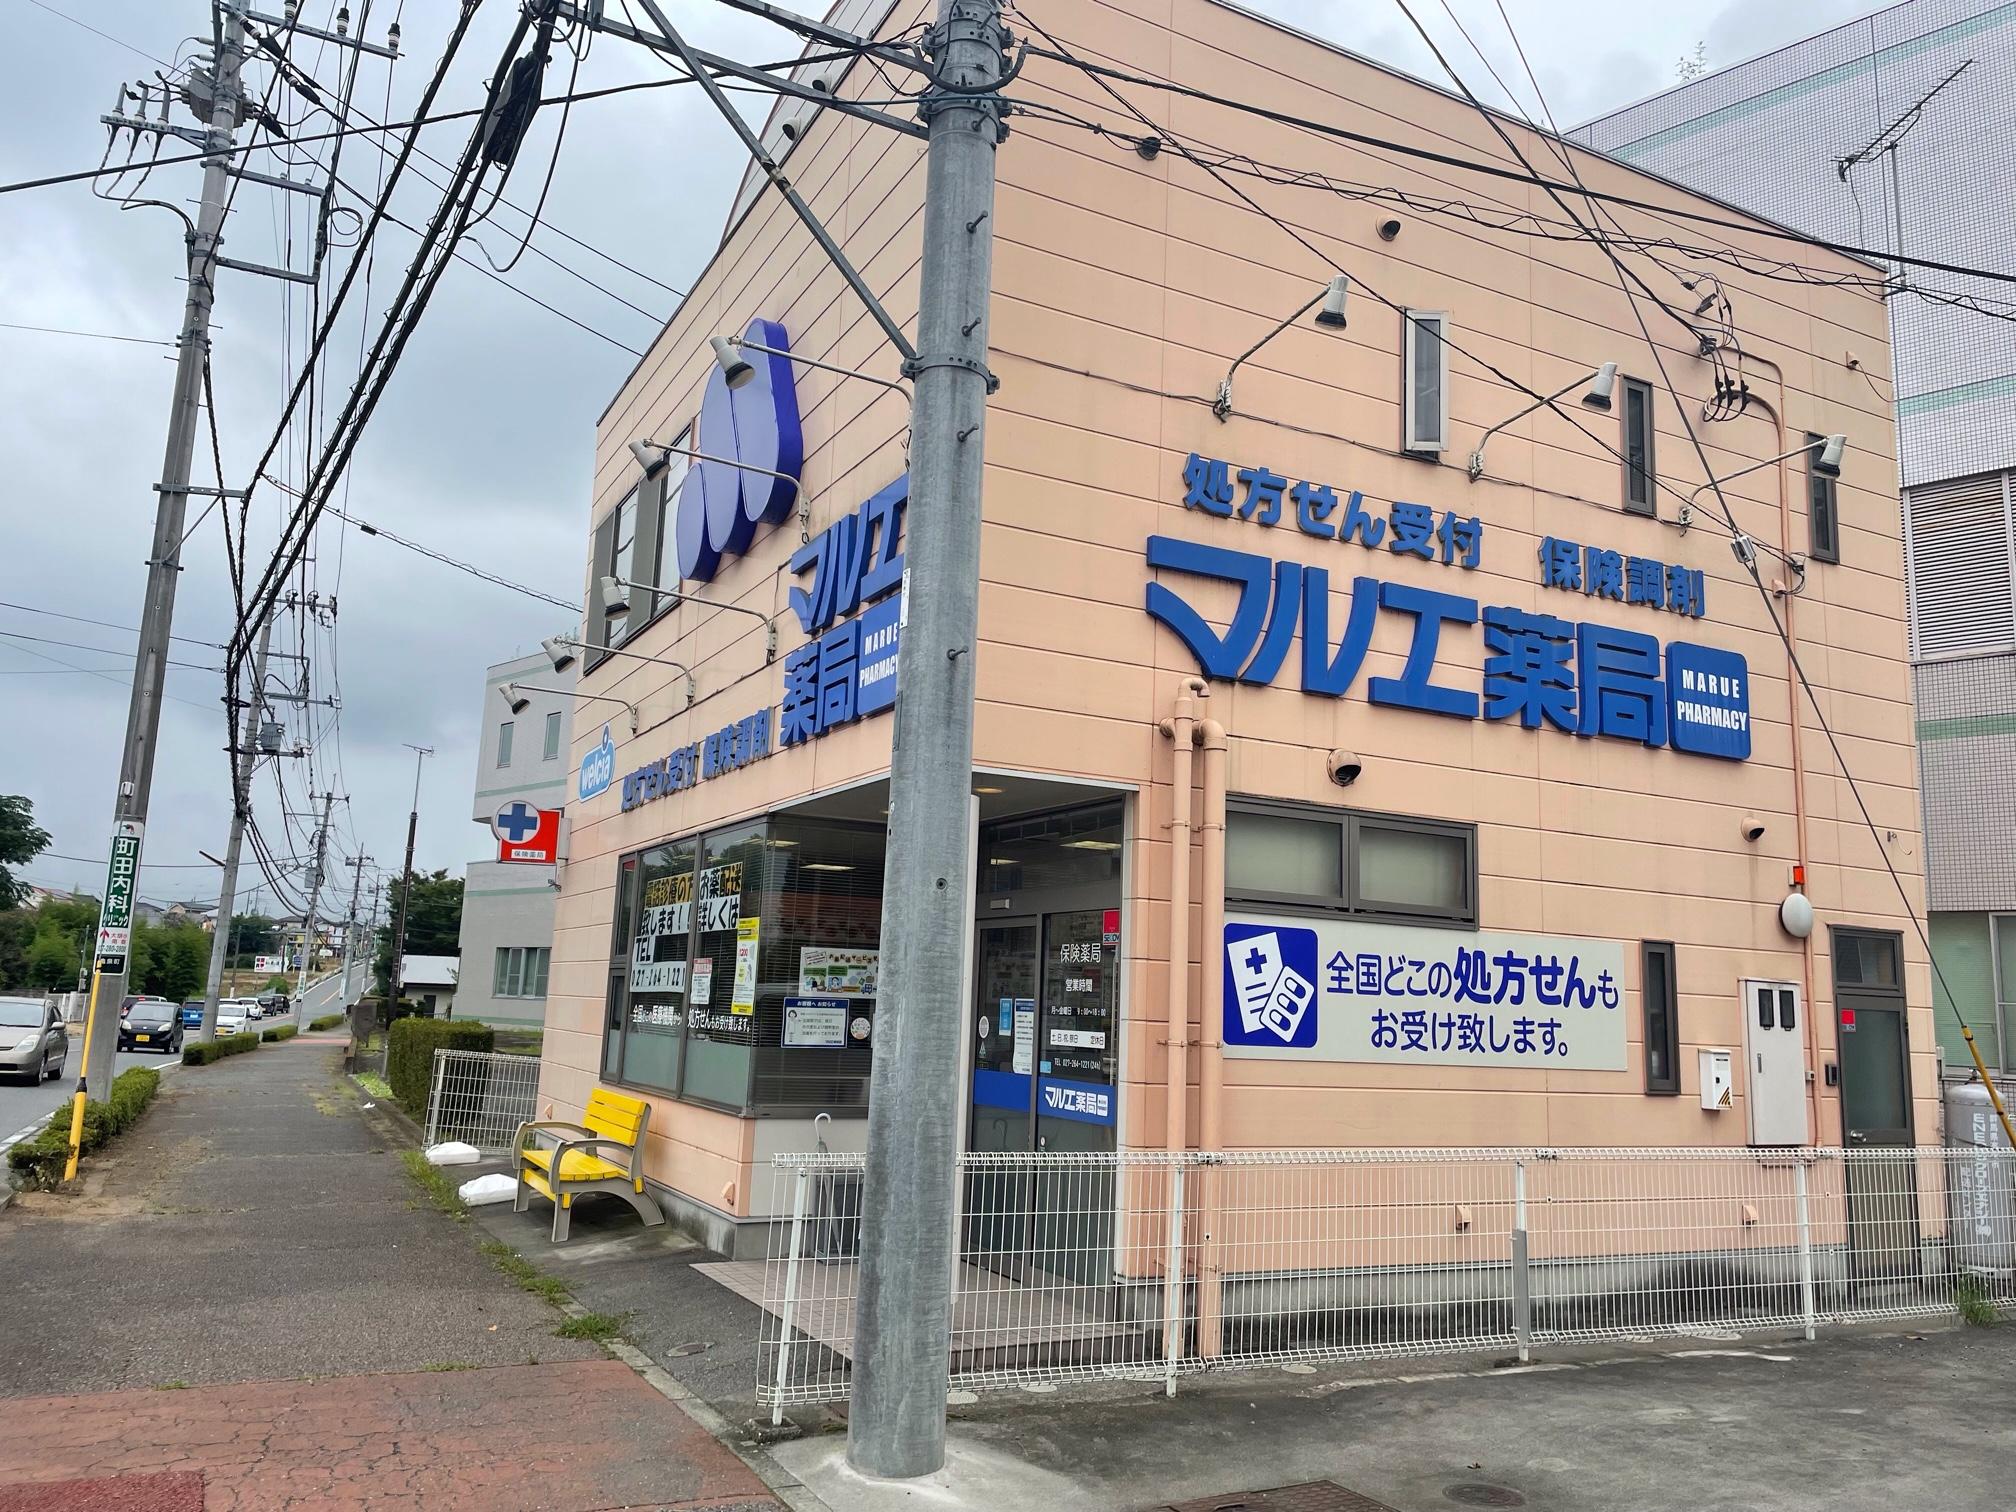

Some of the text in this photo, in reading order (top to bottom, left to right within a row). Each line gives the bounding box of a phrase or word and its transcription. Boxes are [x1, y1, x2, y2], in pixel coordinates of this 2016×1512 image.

[1183, 453, 1704, 618] 処方せん受付 保険調剤
[865, 622, 898, 655] MARUE
[1146, 535, 1666, 748] マルエ薬局
[780, 620, 862, 747] 薬局
[1682, 669, 1740, 700] MARUE
[1677, 700, 1748, 733] PHARMACY
[581, 753, 611, 791] welcia
[109, 837, 137, 913] 町田内科
[636, 937, 651, 962] TEL
[1060, 943, 1101, 963] 保険薬局
[1065, 979, 1093, 992] 営業時間
[1326, 946, 1619, 1010] 全国どこの処方せんも
[1371, 1008, 1569, 1057] お受け致します。
[1045, 1086, 1097, 1115] マルエ薬局
